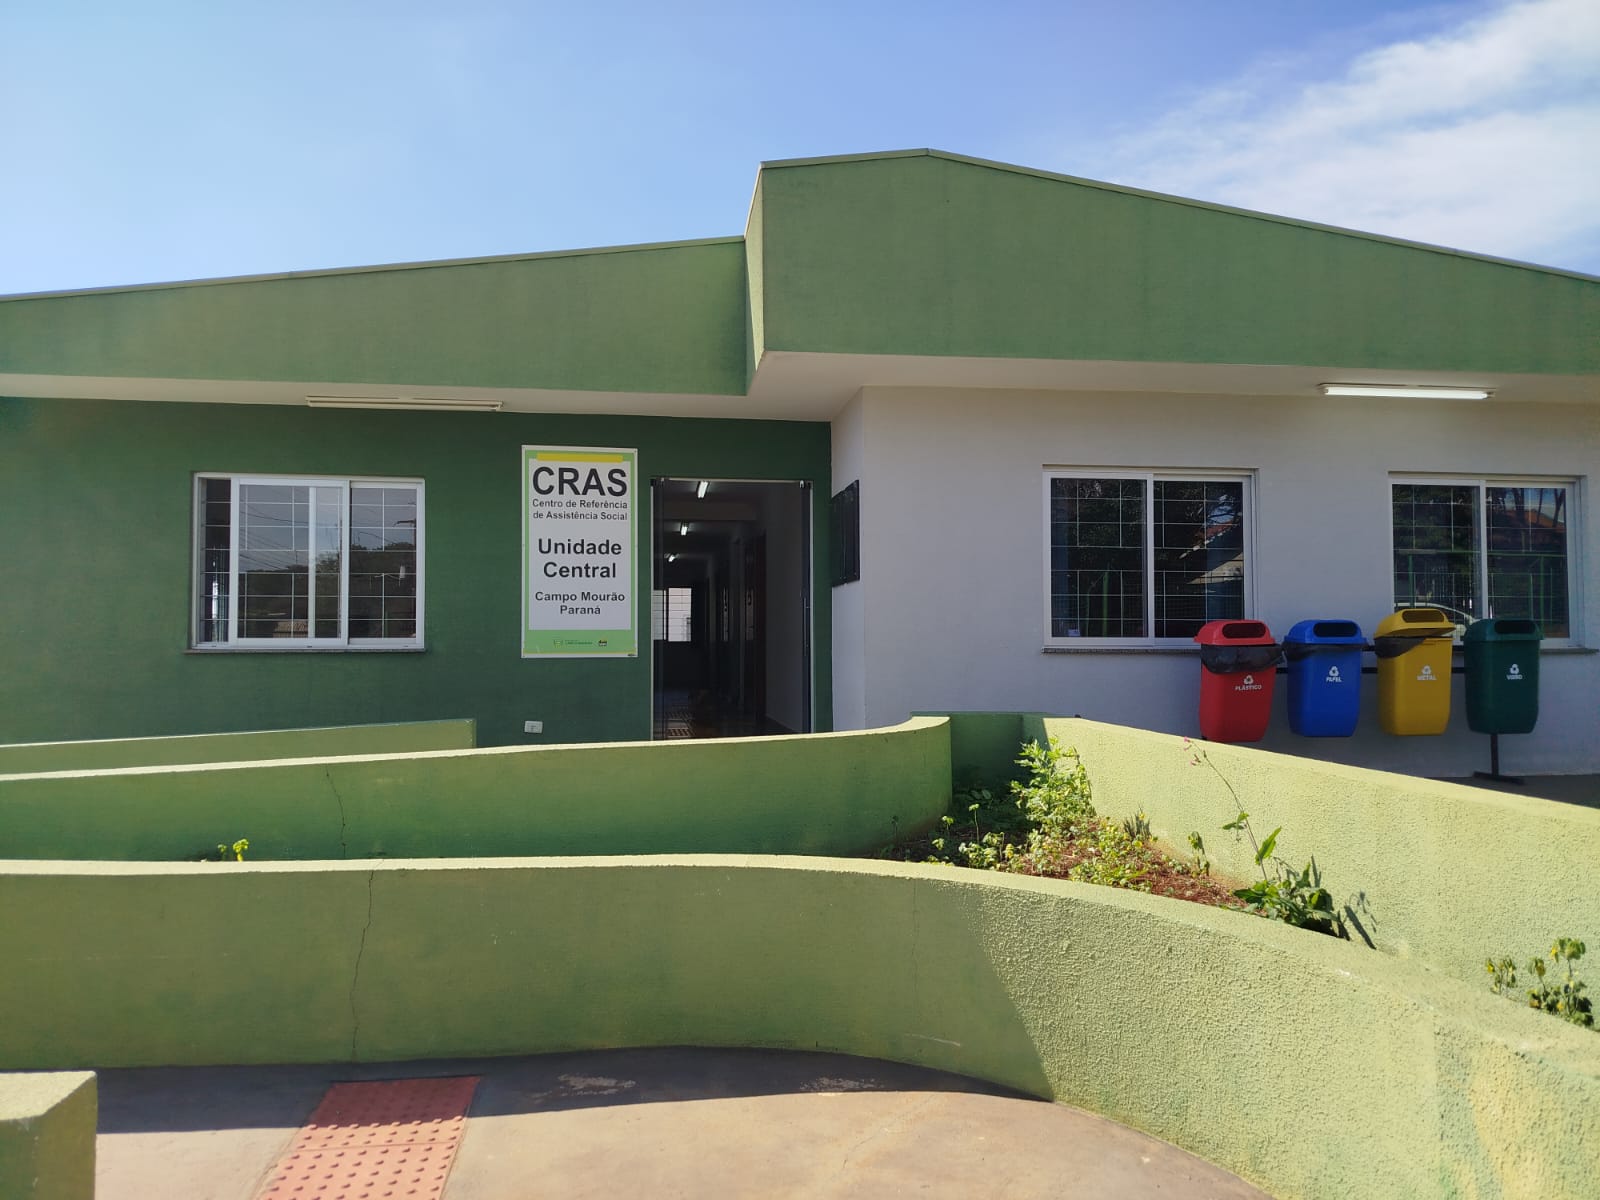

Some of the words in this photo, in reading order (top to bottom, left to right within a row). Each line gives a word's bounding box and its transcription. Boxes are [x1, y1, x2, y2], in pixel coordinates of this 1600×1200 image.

[532, 466, 628, 497] CRAS
[532, 498, 563, 508] Centro
[565, 499, 577, 508] de
[579, 499, 628, 509] Referência
[532, 510, 544, 519] de
[545, 511, 598, 520] Assistência
[600, 511, 628, 521] Social
[538, 538, 622, 555] Unidade
[543, 561, 616, 578] Central
[535, 591, 578, 603] Campo
[581, 591, 625, 602] Mourão
[559, 604, 601, 615] Paraná
